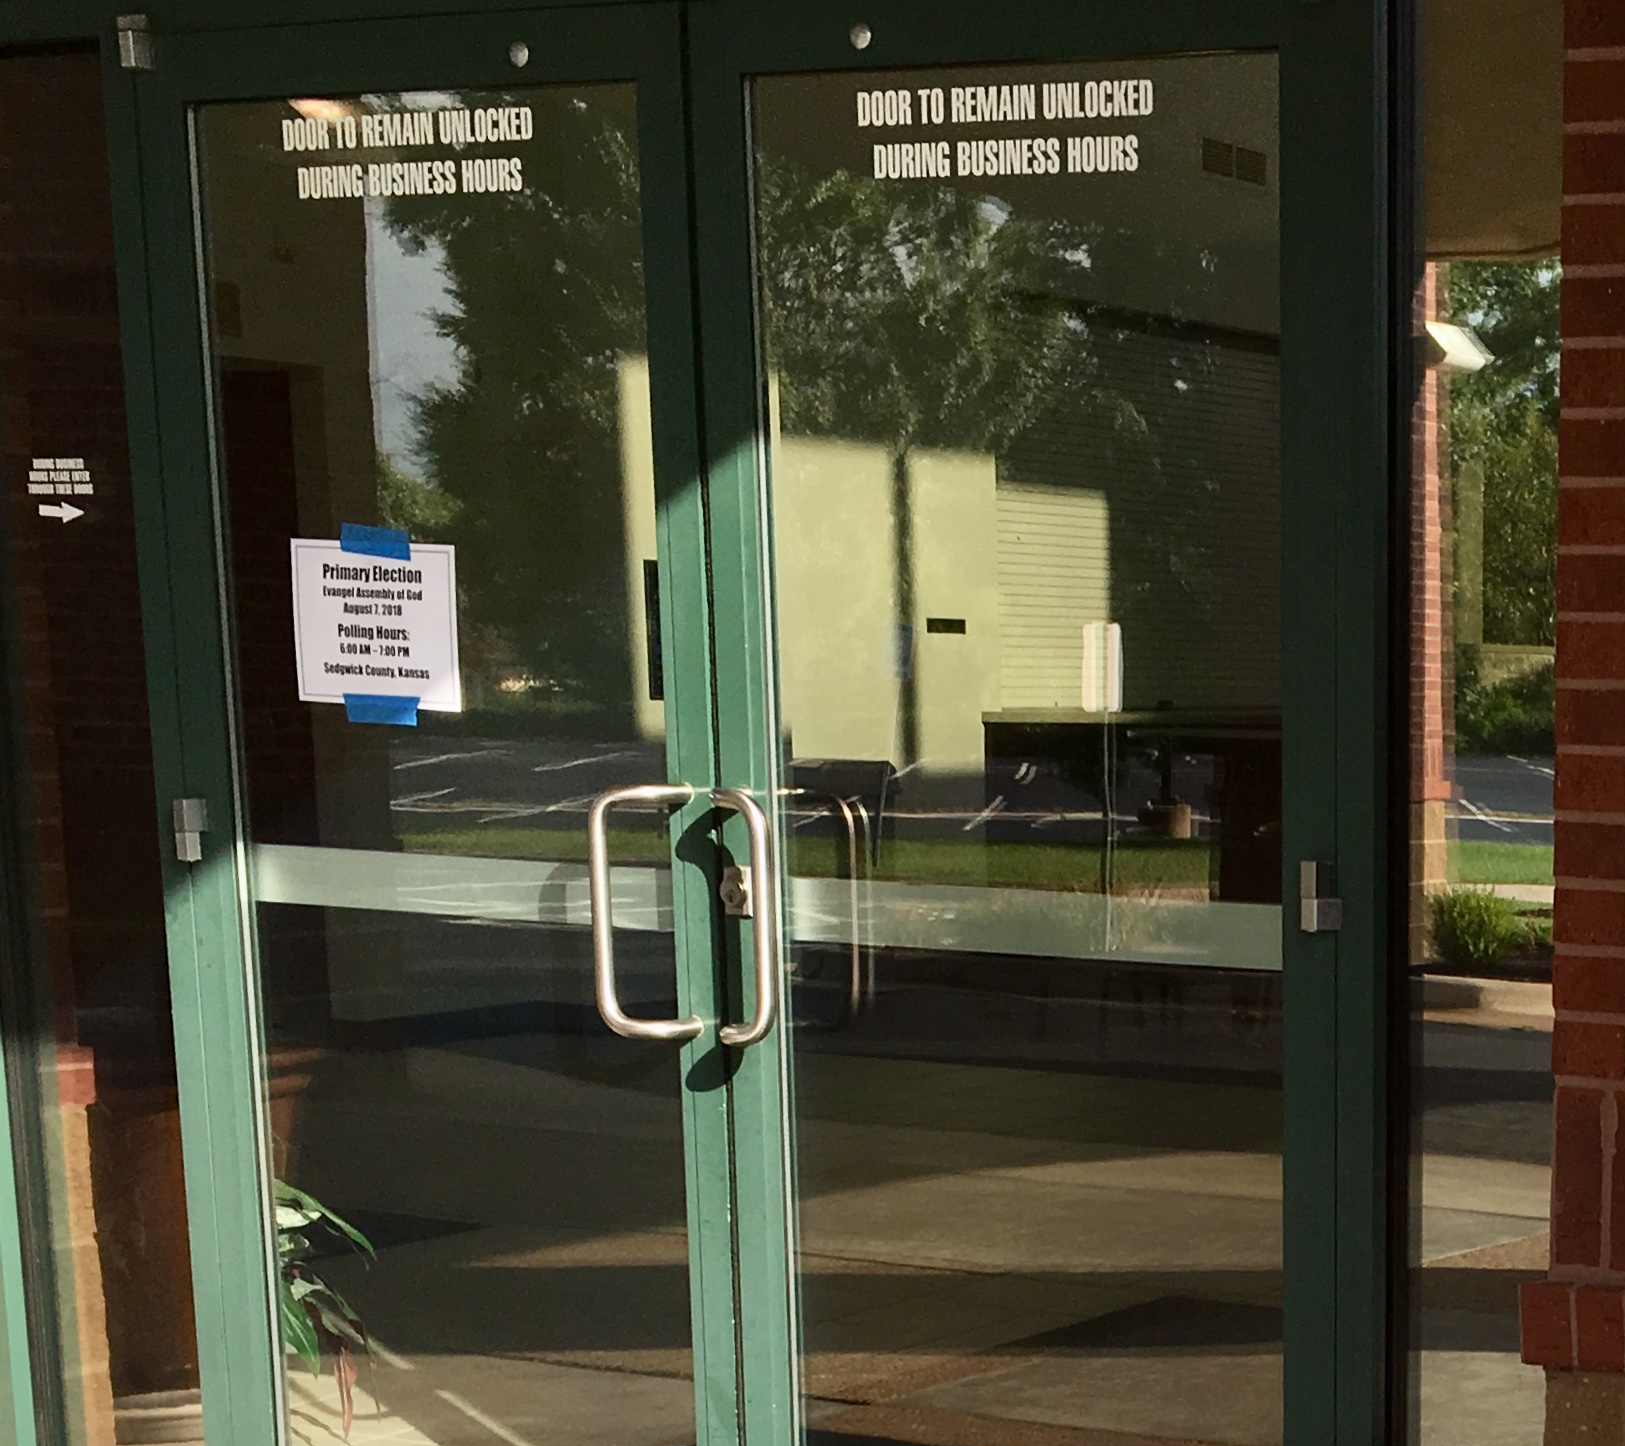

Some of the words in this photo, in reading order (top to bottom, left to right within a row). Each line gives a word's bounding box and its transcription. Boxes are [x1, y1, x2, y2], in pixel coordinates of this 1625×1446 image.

[857, 89, 912, 127] DOOR
[917, 87, 945, 125] TO
[951, 84, 1036, 123] REMAIN
[1042, 79, 1154, 120] UNLOCKED
[282, 117, 330, 151] DOOR
[335, 115, 357, 149] TO
[361, 111, 434, 147] REMAIN
[438, 106, 533, 144] UNLOCKED
[873, 141, 950, 179] DURING
[957, 137, 1060, 177] BUSINESS
[1067, 134, 1139, 173] HOURS
[297, 164, 364, 199] DURING
[368, 160, 456, 197] BUSINESS
[461, 157, 523, 193] HOURS
[322, 563, 370, 583] Primary
[372, 565, 422, 584] Election
[322, 585, 355, 599] Evangel
[356, 586, 395, 601] Assembly
[343, 602, 373, 616] August
[381, 604, 403, 617] 2018
[337, 623, 374, 641] Polling
[376, 625, 411, 642] Hours:
[359, 643, 372, 655] AM
[397, 646, 410, 658] PM
[323, 661, 364, 676] Sedgwick
[397, 666, 430, 680] Kansas
